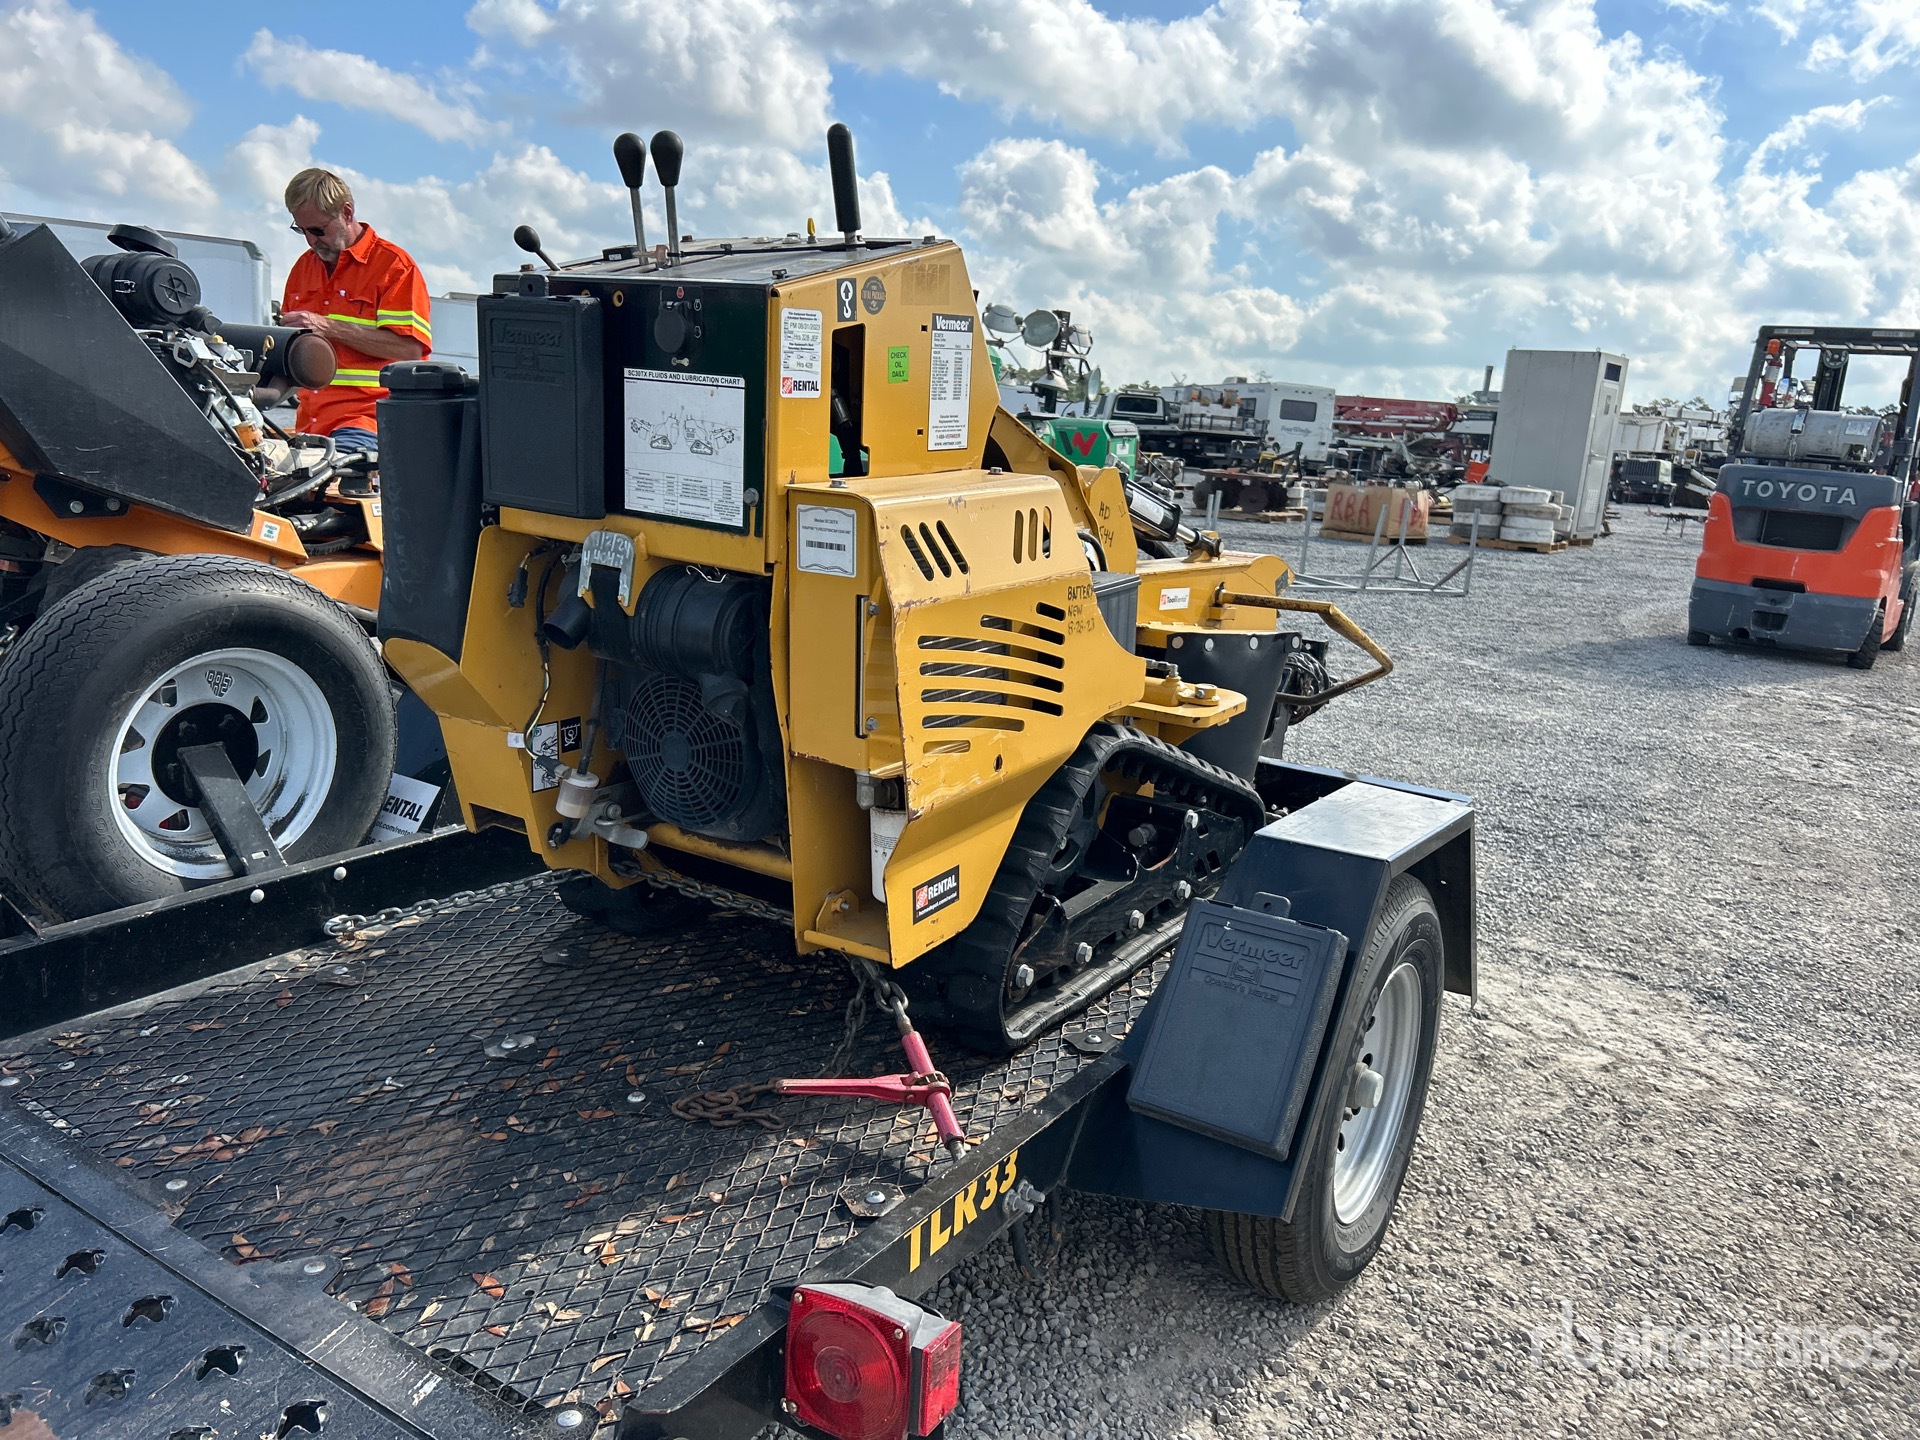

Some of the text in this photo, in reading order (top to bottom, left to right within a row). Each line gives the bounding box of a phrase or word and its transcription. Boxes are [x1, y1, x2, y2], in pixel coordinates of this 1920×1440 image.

[936, 315, 970, 331] Vermeer
[891, 351, 907, 359] CHECK
[628, 370, 648, 378] SC30TX
[649, 372, 668, 380] FLUIDS
[668, 373, 681, 381] AND
[681, 375, 719, 384] LUBRICATION
[793, 380, 819, 392] RENTAL
[1742, 479, 1857, 505] TOYOTA
[1068, 604, 1083, 617] NEW
[381, 795, 424, 822] ENTAL
[928, 874, 957, 900] RENTAL
[1203, 925, 1304, 970] Vermeer
